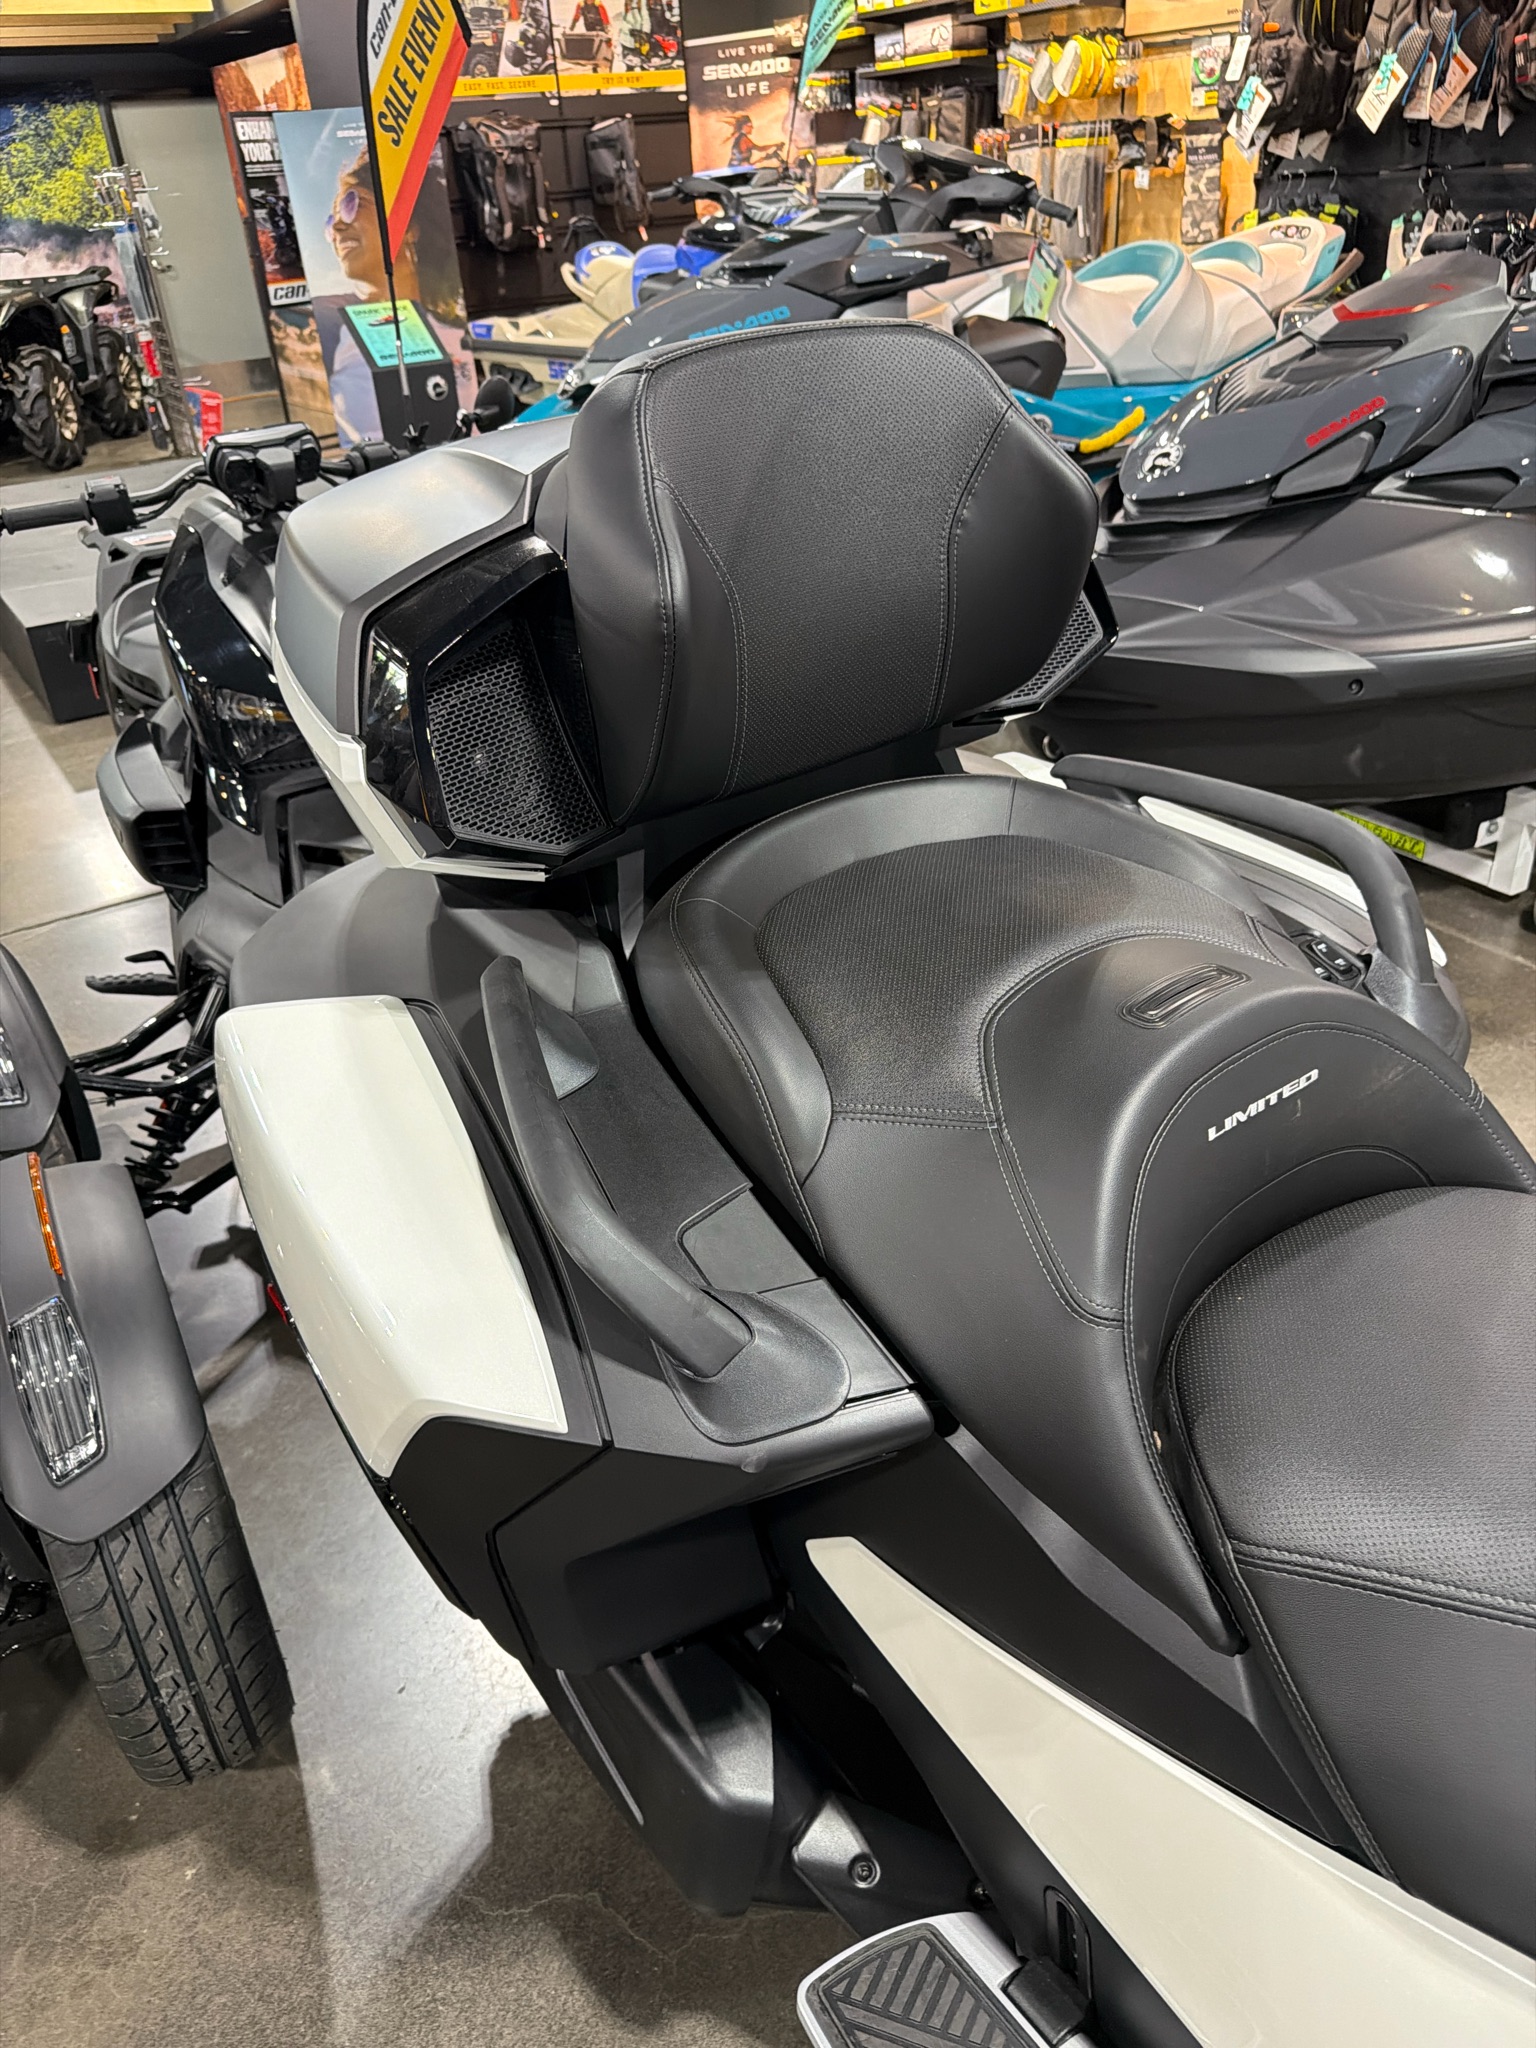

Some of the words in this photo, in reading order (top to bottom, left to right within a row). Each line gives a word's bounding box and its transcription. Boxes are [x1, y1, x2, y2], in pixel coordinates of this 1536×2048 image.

[717, 46, 745, 59] LIVE
[749, 42, 774, 55] THE
[726, 80, 770, 99] LIFE
[377, 64, 418, 148] SALE
[240, 142, 274, 163] YOUR
[1207, 1068, 1319, 1142] LIMITED
